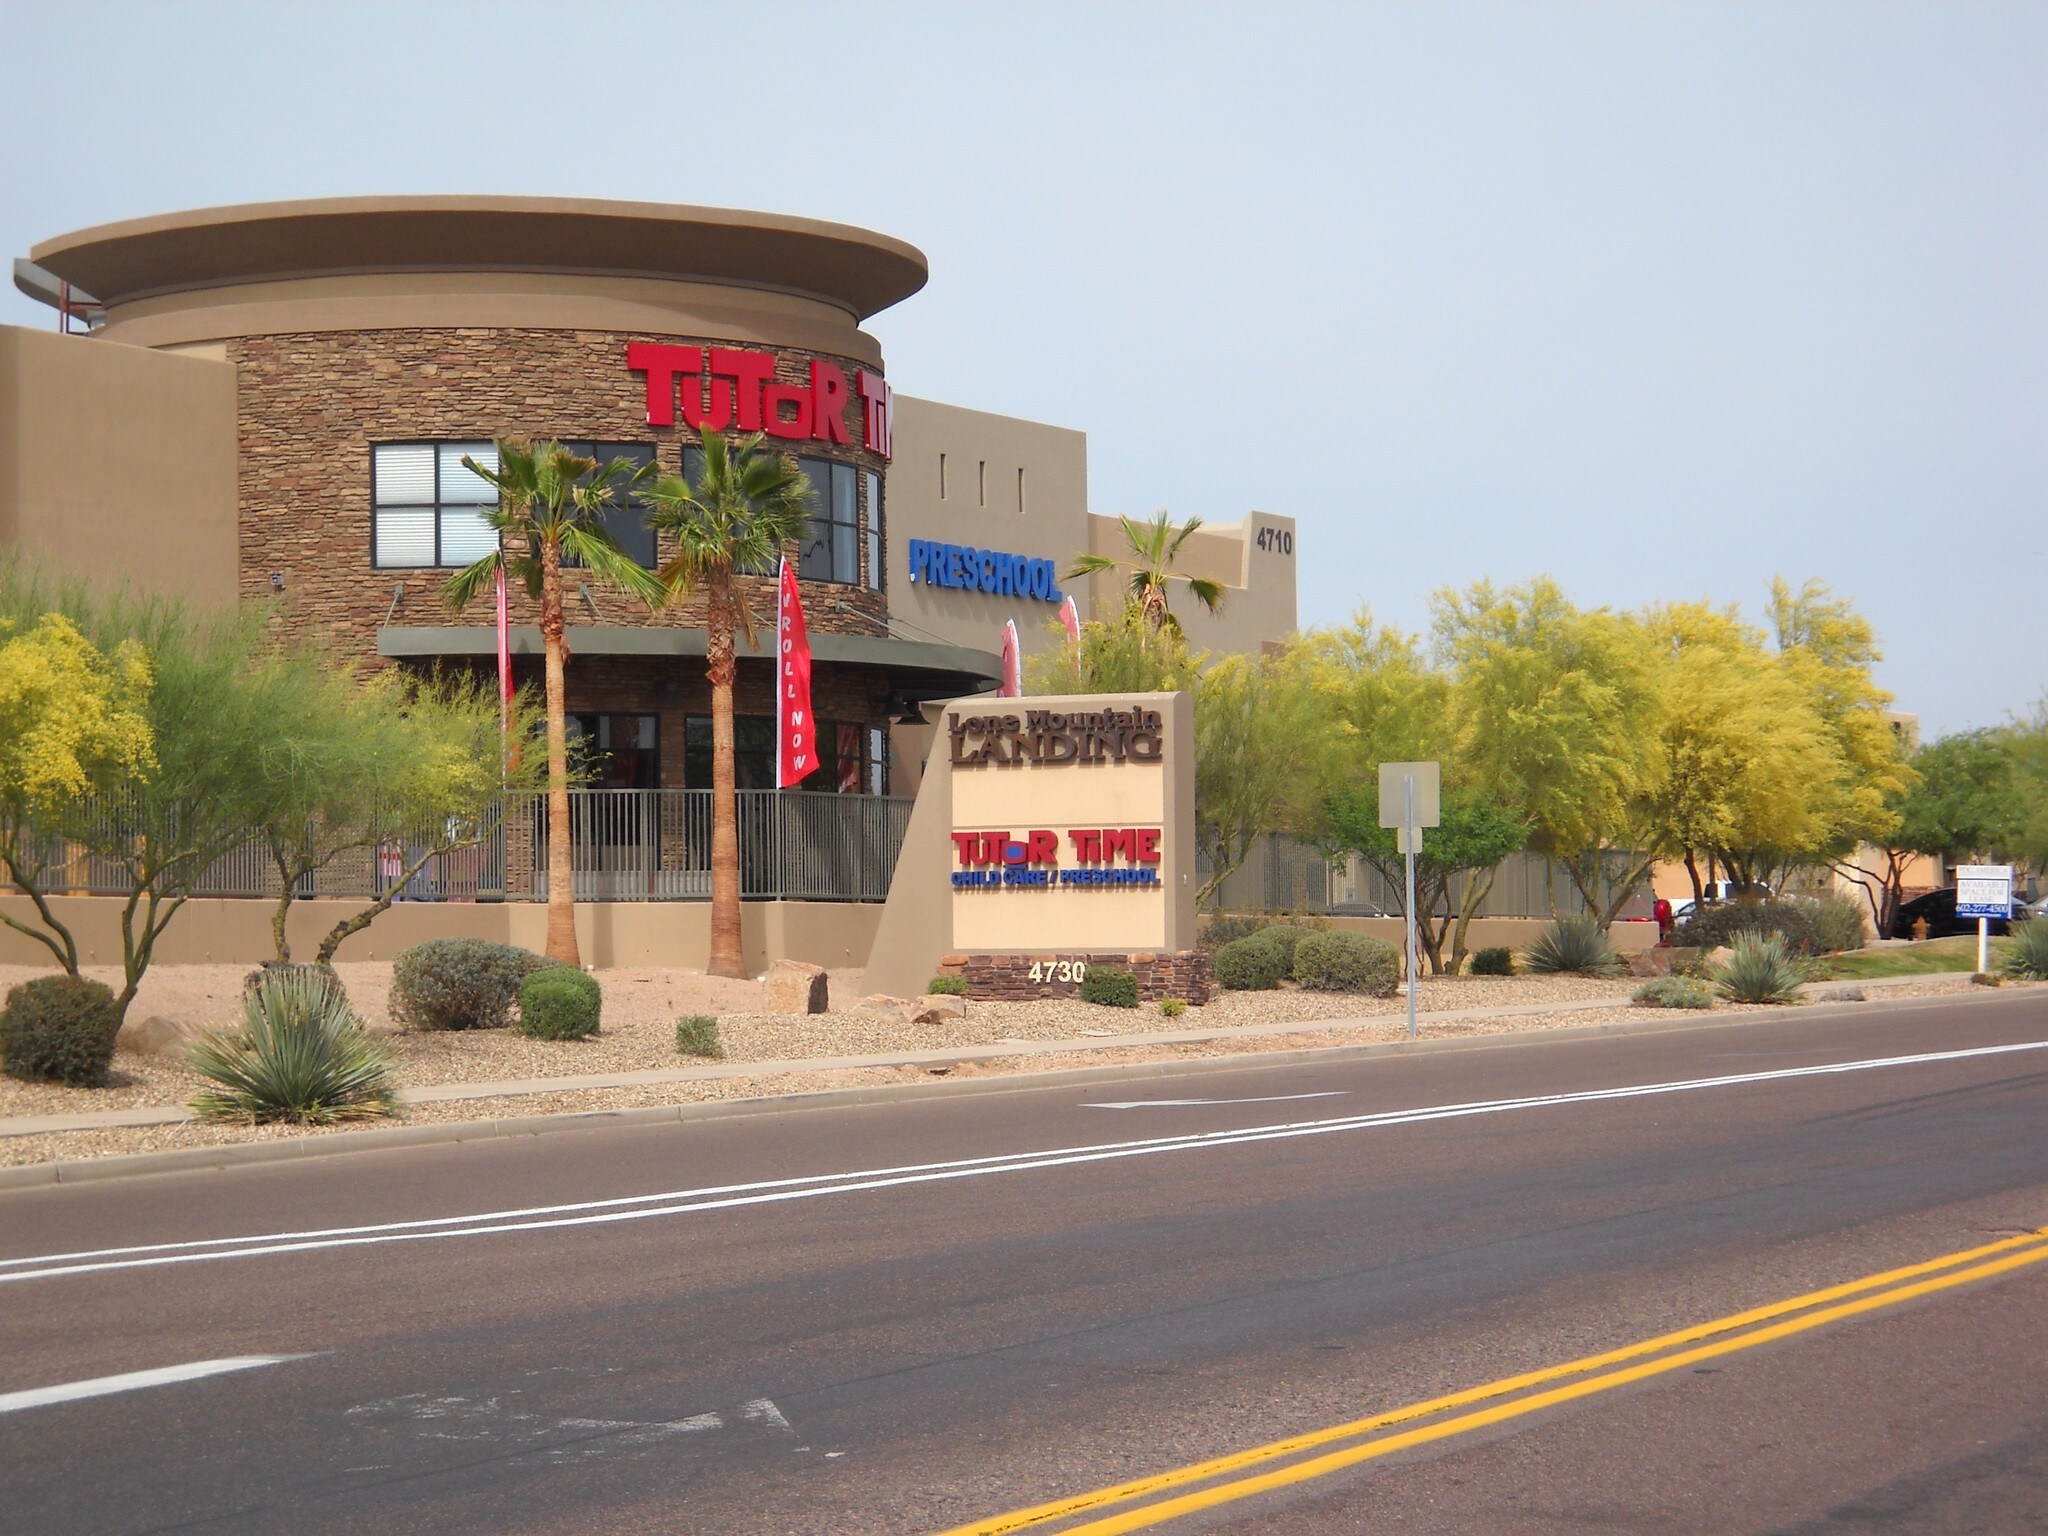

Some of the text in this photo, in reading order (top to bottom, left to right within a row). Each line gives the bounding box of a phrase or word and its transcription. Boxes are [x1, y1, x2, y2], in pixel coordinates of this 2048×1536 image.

[627, 342, 851, 445] TUTOR
[1257, 526, 1292, 555] 4710
[908, 538, 1063, 603] PRESCHOOL
[947, 704, 1163, 733] Lone Mountain
[791, 710, 807, 771] NOW
[948, 729, 1163, 763] LANDING
[951, 829, 1059, 865] TUTOR
[951, 869, 1002, 886] CHILD
[1003, 868, 1047, 885] CARE
[1059, 867, 1161, 884] PRESCHOOL
[1960, 888, 1986, 896] SPACE
[1027, 961, 1086, 983] 4730
